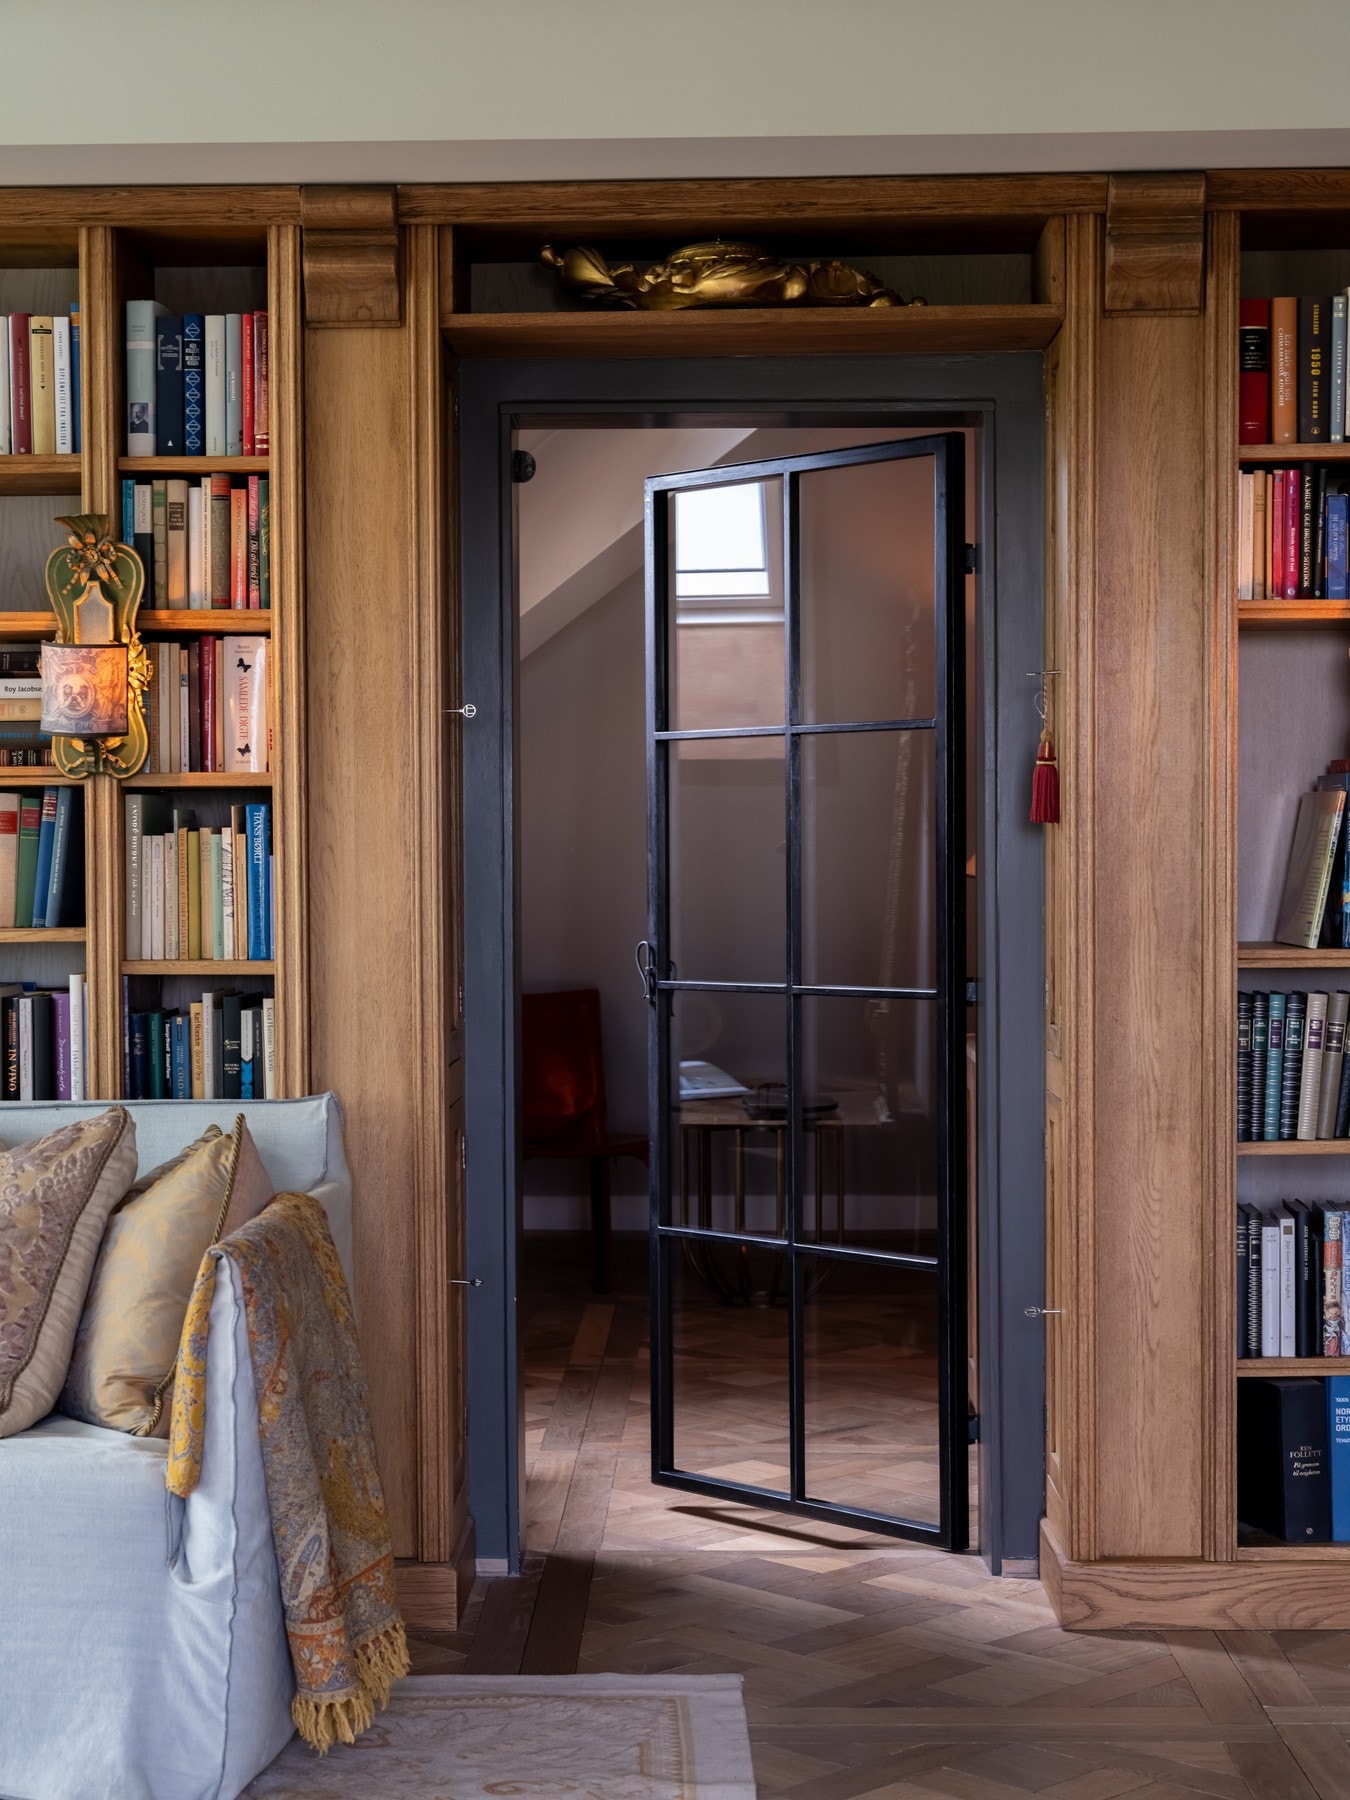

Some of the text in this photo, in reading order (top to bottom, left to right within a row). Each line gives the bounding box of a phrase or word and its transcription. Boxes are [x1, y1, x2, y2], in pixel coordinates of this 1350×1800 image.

[1282, 334, 1293, 400] En halv gul sol
[1311, 347, 1321, 375] 1950
[239, 675, 248, 739] SAMLEDE DIGTE
[131, 804, 140, 833] ANDRÉ
[254, 812, 262, 864] HANS BØRLI
[254, 912, 261, 924] OG
[9, 1048, 16, 1061] IN
[8, 1065, 16, 1091] VIVO
[1290, 1450, 1322, 1458] FOLLETT
